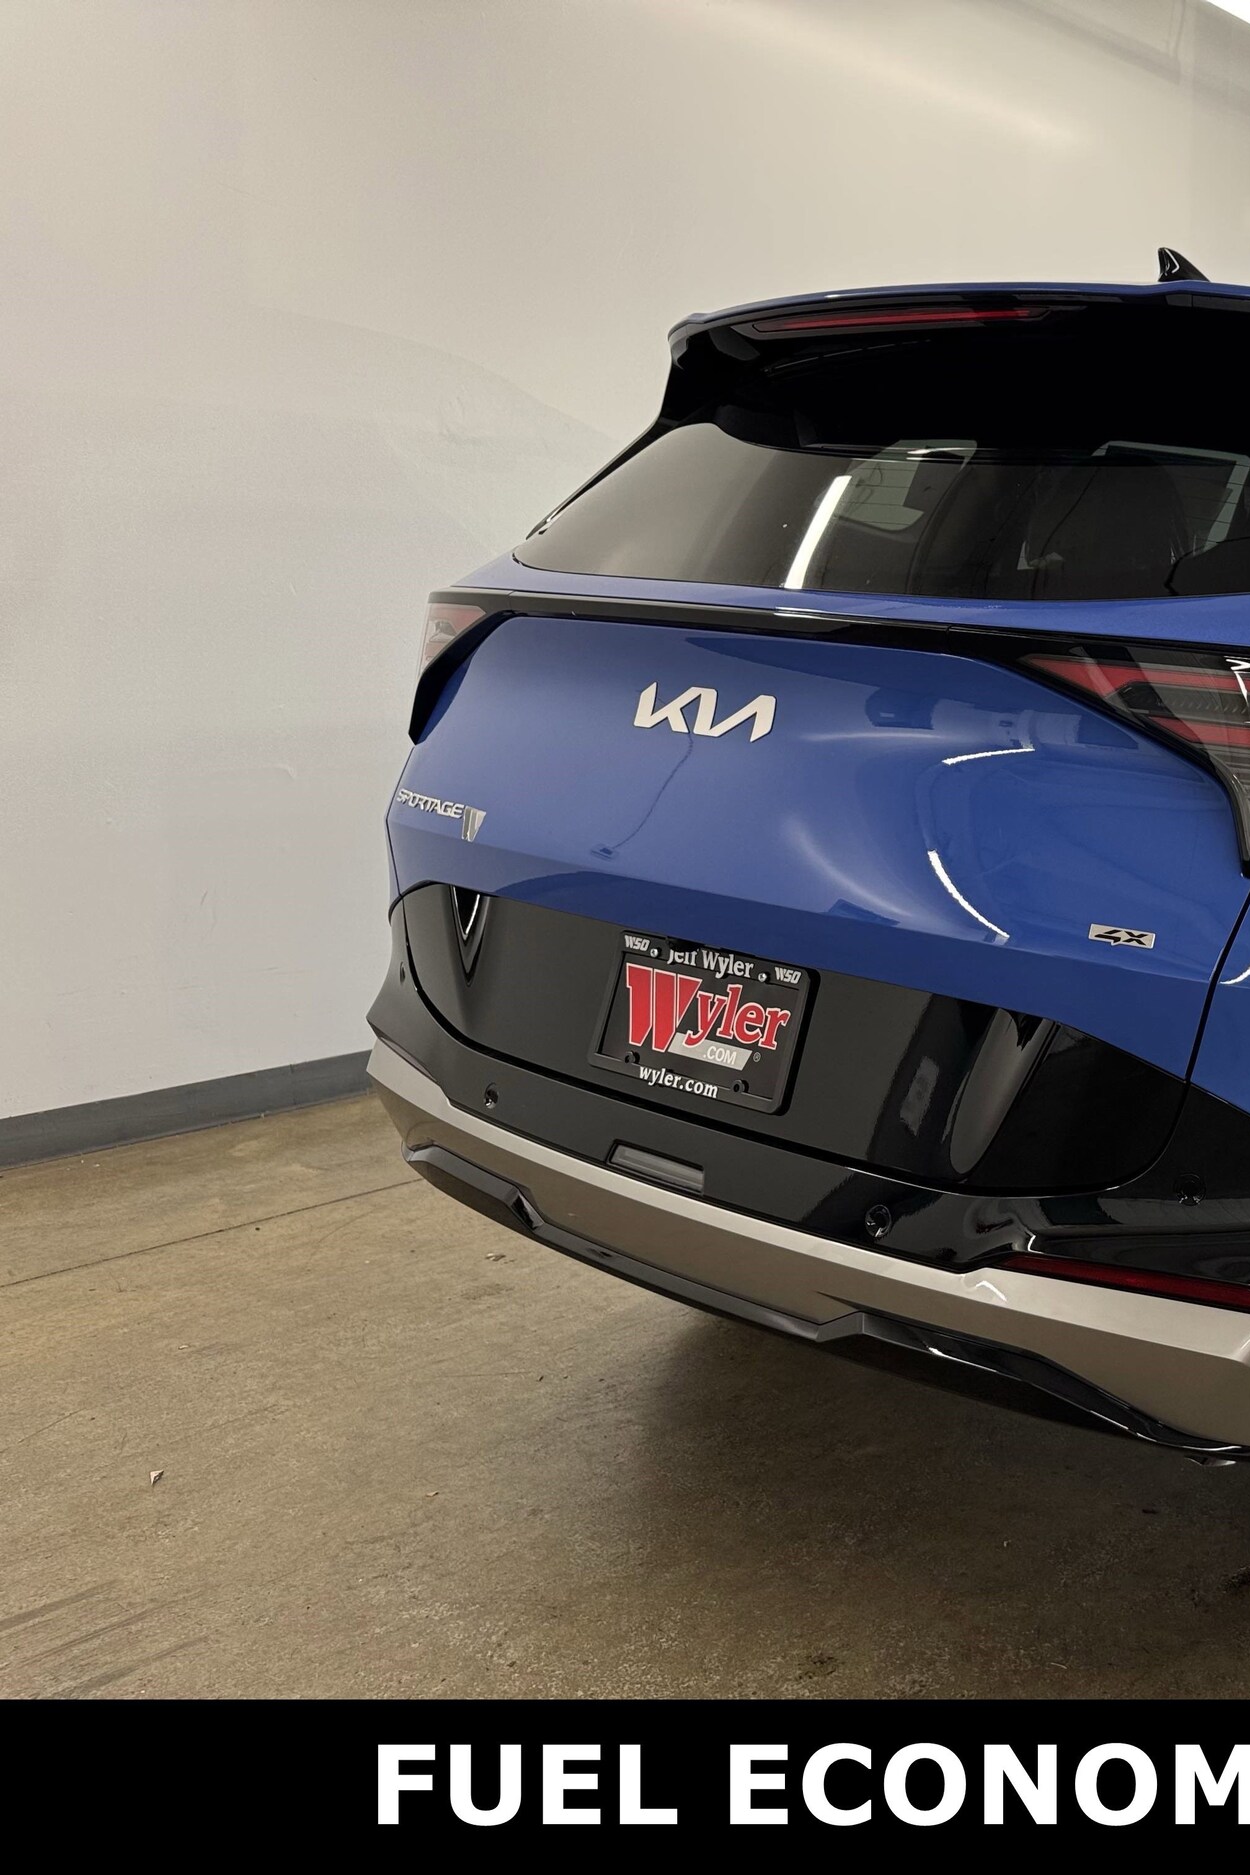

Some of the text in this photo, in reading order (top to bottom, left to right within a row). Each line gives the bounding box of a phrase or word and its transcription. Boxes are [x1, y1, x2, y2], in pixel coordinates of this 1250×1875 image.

[633, 681, 776, 743] KIA
[397, 788, 465, 819] SPORTAGE
[667, 948, 754, 979] Jeff Wyler
[626, 962, 791, 1053] Wyler
[638, 1065, 719, 1098] wyler.com
